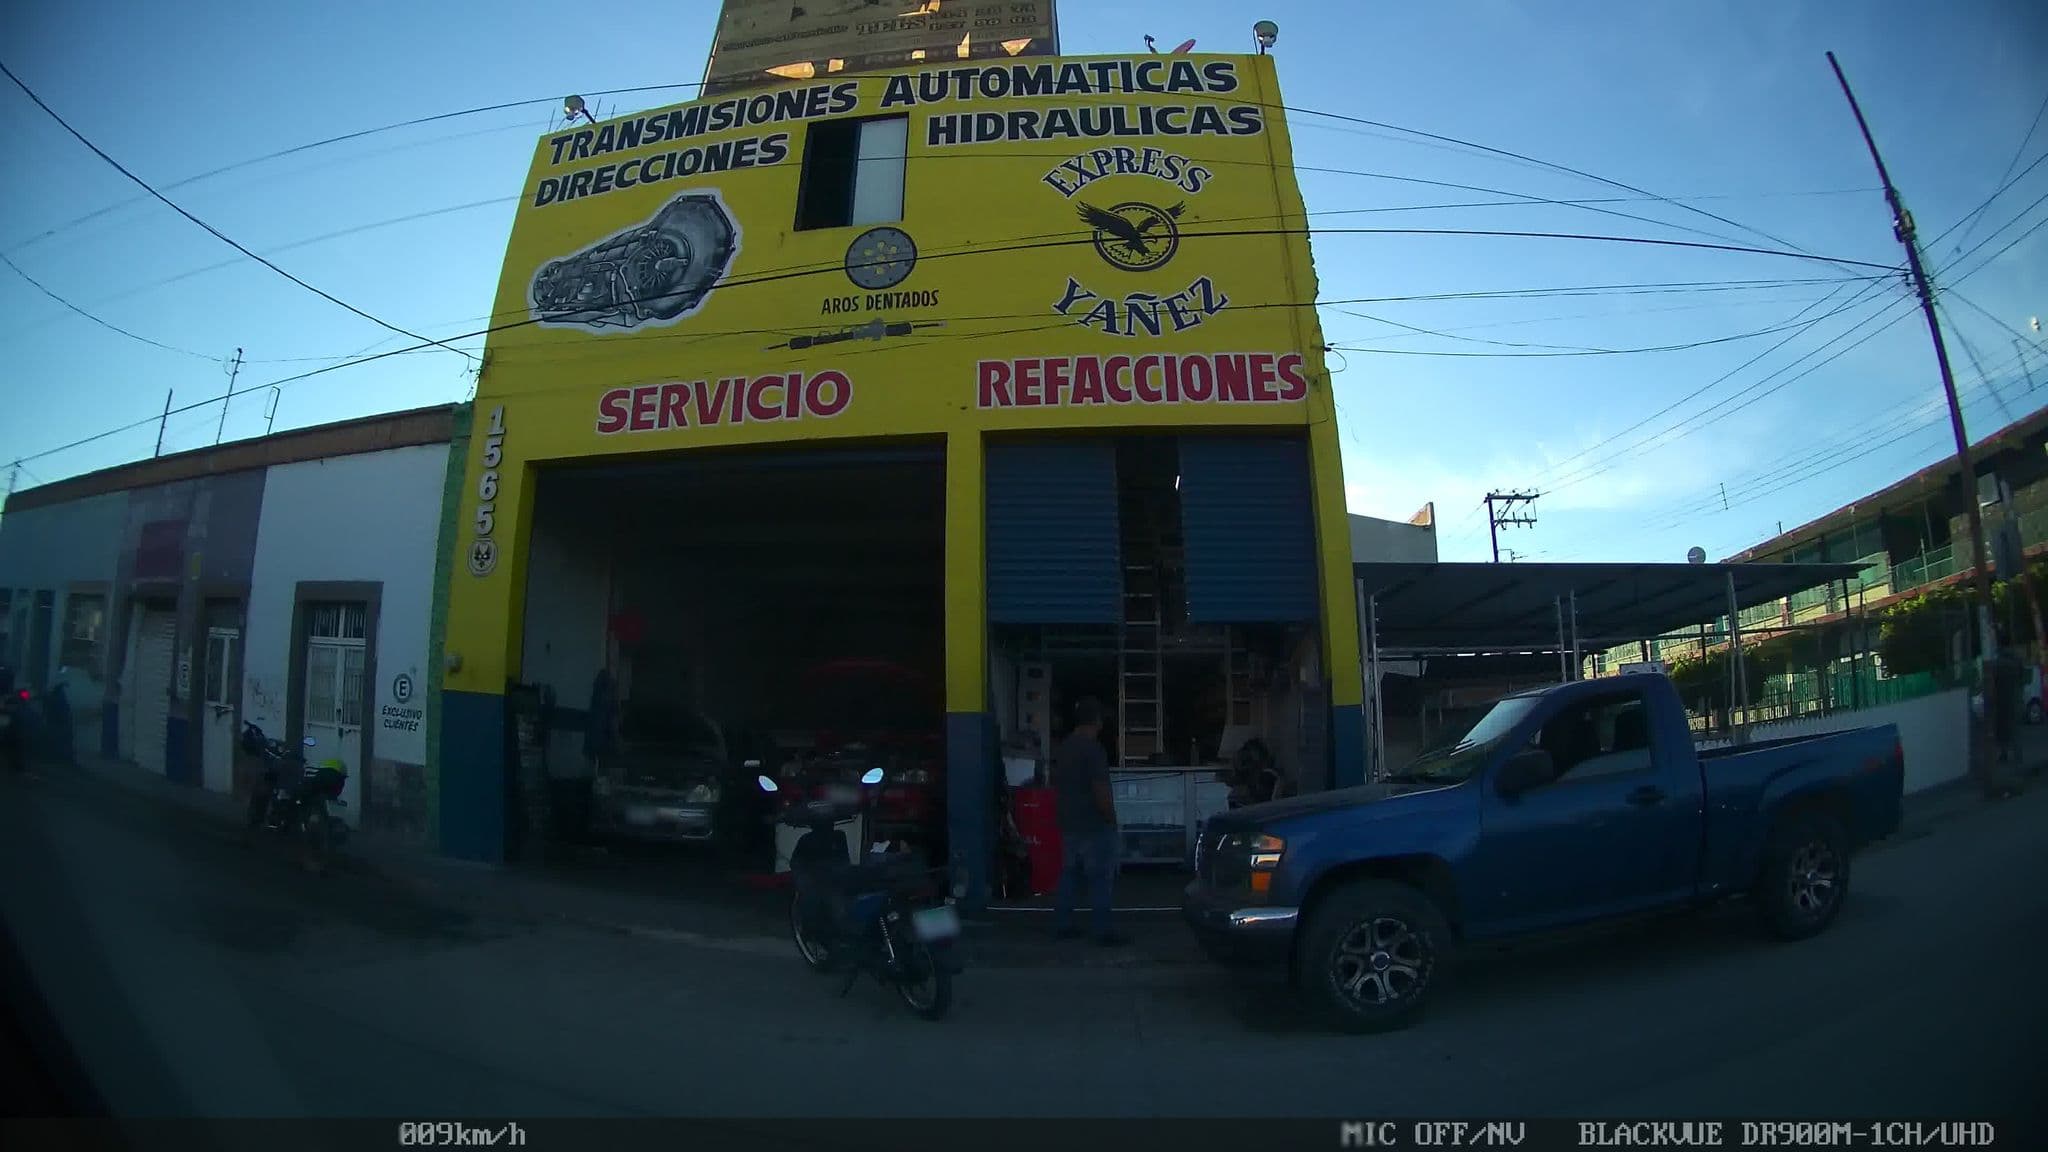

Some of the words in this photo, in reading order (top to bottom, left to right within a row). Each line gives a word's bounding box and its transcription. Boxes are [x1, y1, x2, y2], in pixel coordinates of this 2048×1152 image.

[550, 82, 858, 165] TRANSMISIONES
[880, 61, 1239, 108] AUTOMATICAS
[534, 133, 789, 207] DIRECCIONES
[927, 106, 1263, 146] HIDRAULICAS
[1042, 146, 1213, 199] EXPRESS
[821, 295, 859, 315] AROS
[865, 290, 940, 311] DENTADOS
[1053, 276, 1228, 337] YAÑEZ
[597, 370, 852, 433] SERVICIO
[978, 354, 1308, 408] REFACCIONES
[474, 404, 506, 536] 1565
[382, 705, 423, 720] EXCLUSIVO
[399, 680, 407, 697] E
[383, 718, 419, 732] CLIENTES
